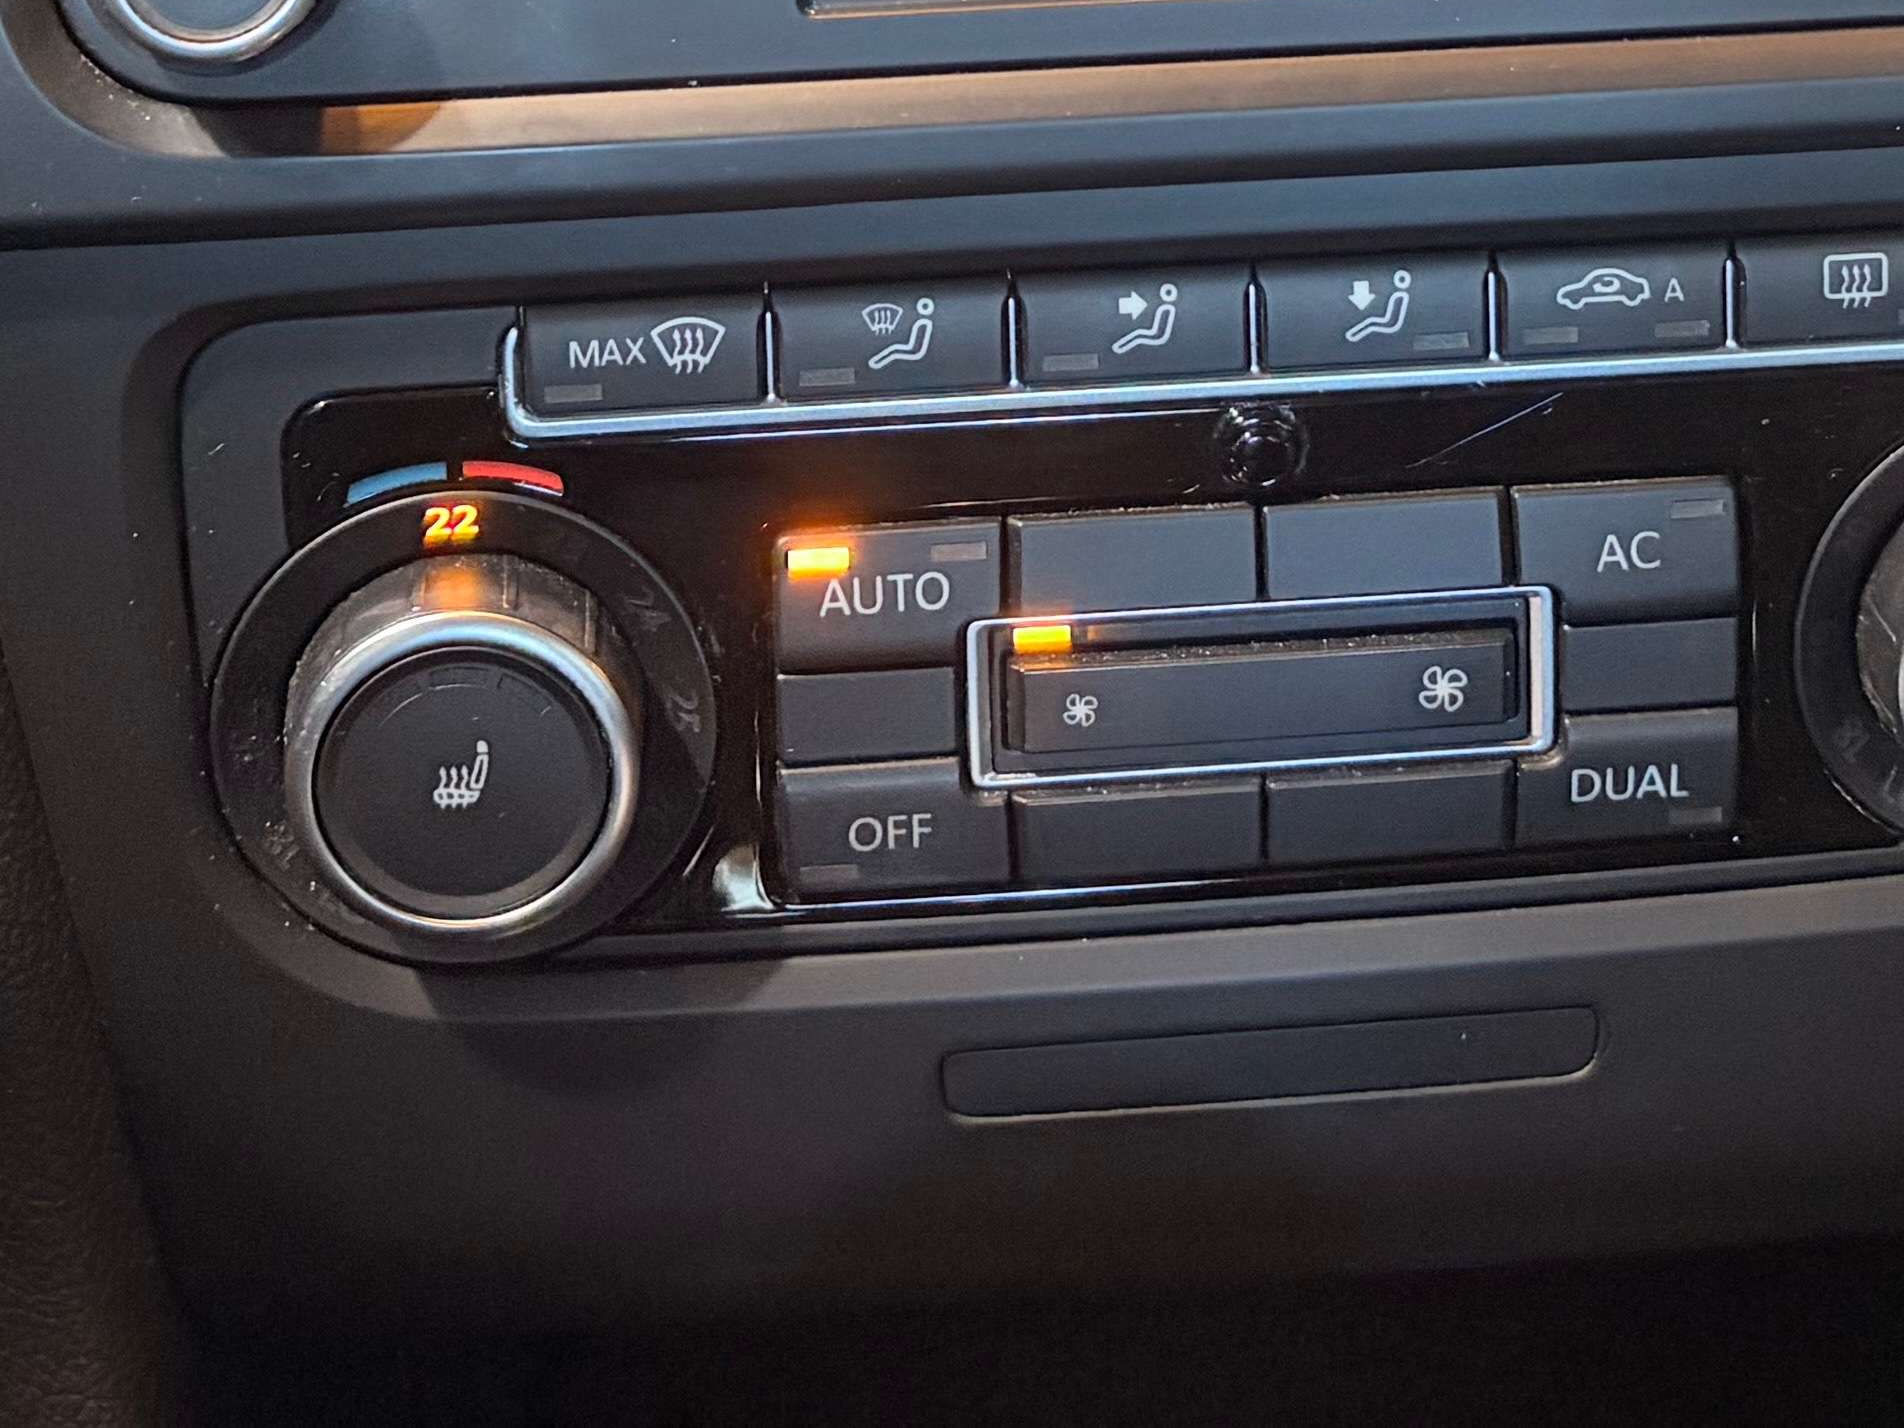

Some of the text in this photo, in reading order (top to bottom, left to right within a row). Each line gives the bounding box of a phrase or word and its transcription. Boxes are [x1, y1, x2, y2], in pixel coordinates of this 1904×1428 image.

[1664, 281, 1685, 303] A
[567, 337, 647, 370] MAX
[423, 503, 480, 546] 22
[1595, 530, 1663, 575] AC
[818, 571, 952, 620] AUTO
[1569, 763, 1691, 804] DUAL
[847, 812, 934, 853] OFF
